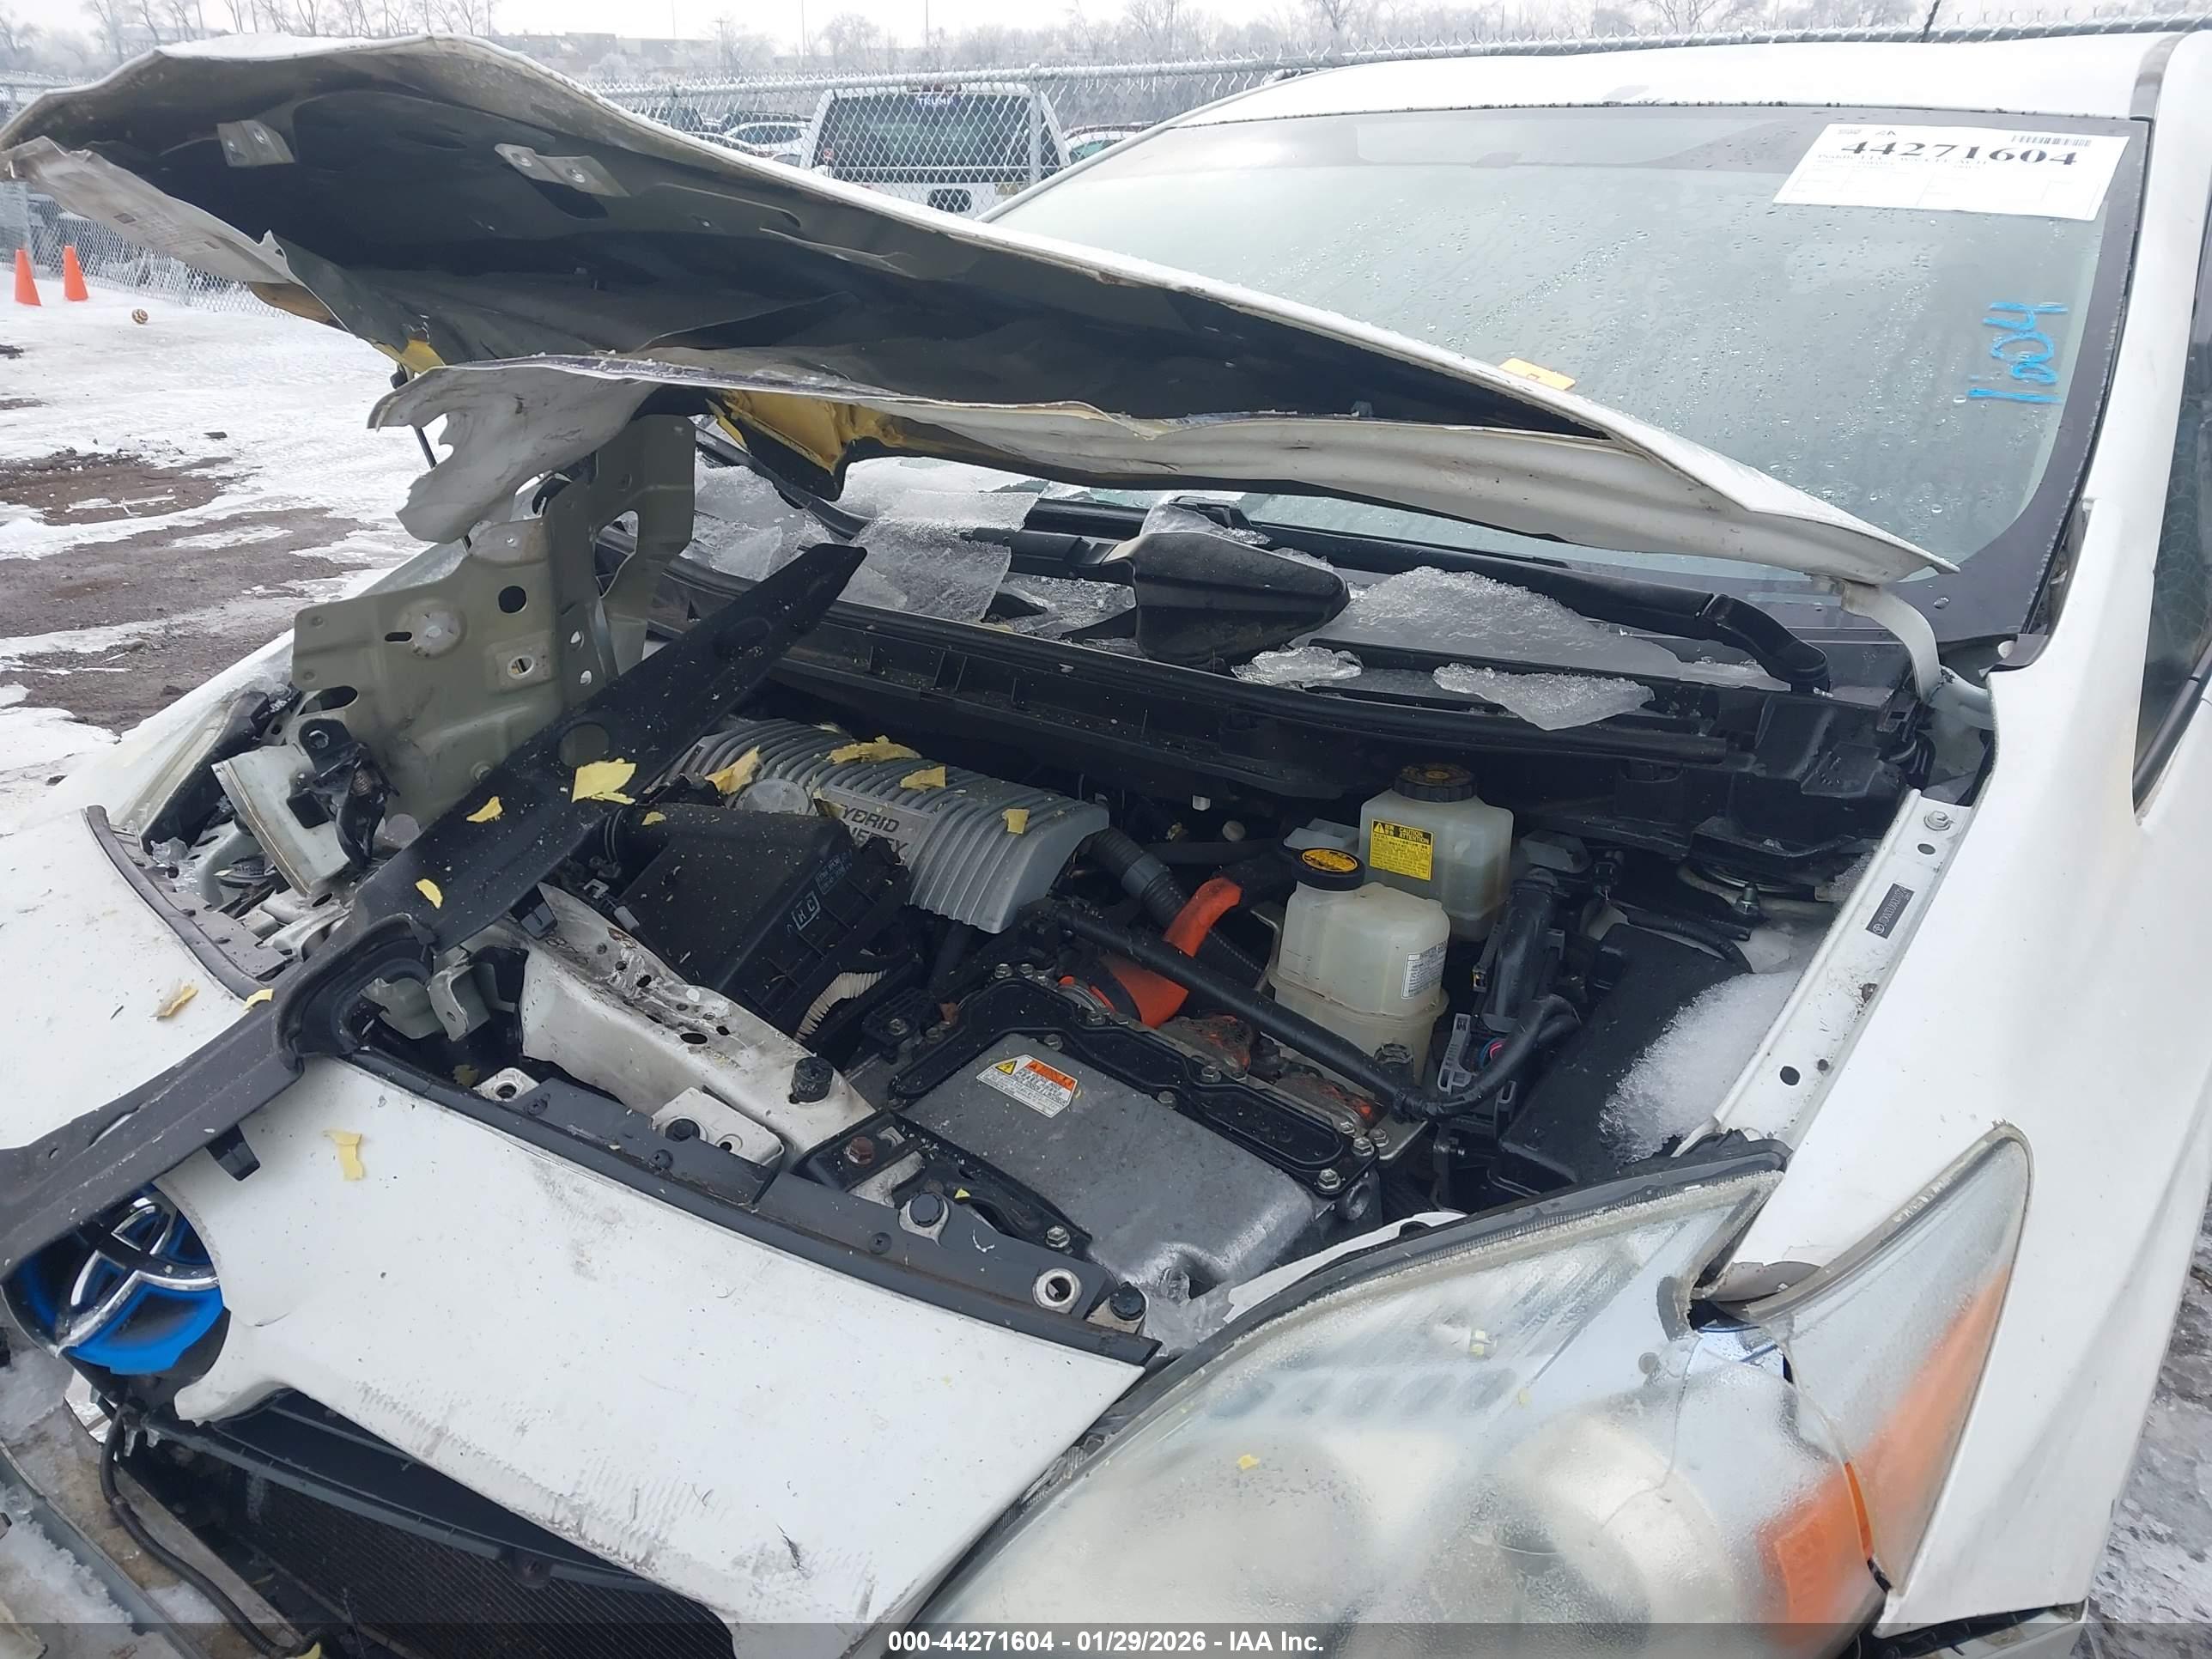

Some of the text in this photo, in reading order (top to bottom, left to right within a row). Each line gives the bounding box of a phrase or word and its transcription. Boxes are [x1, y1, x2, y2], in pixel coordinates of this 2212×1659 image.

[1841, 141, 2077, 166] 44271604
[840, 804, 900, 833] YBRID
[1399, 826, 1423, 837] CAUTION
[1399, 833, 1429, 844] ATTENTION
